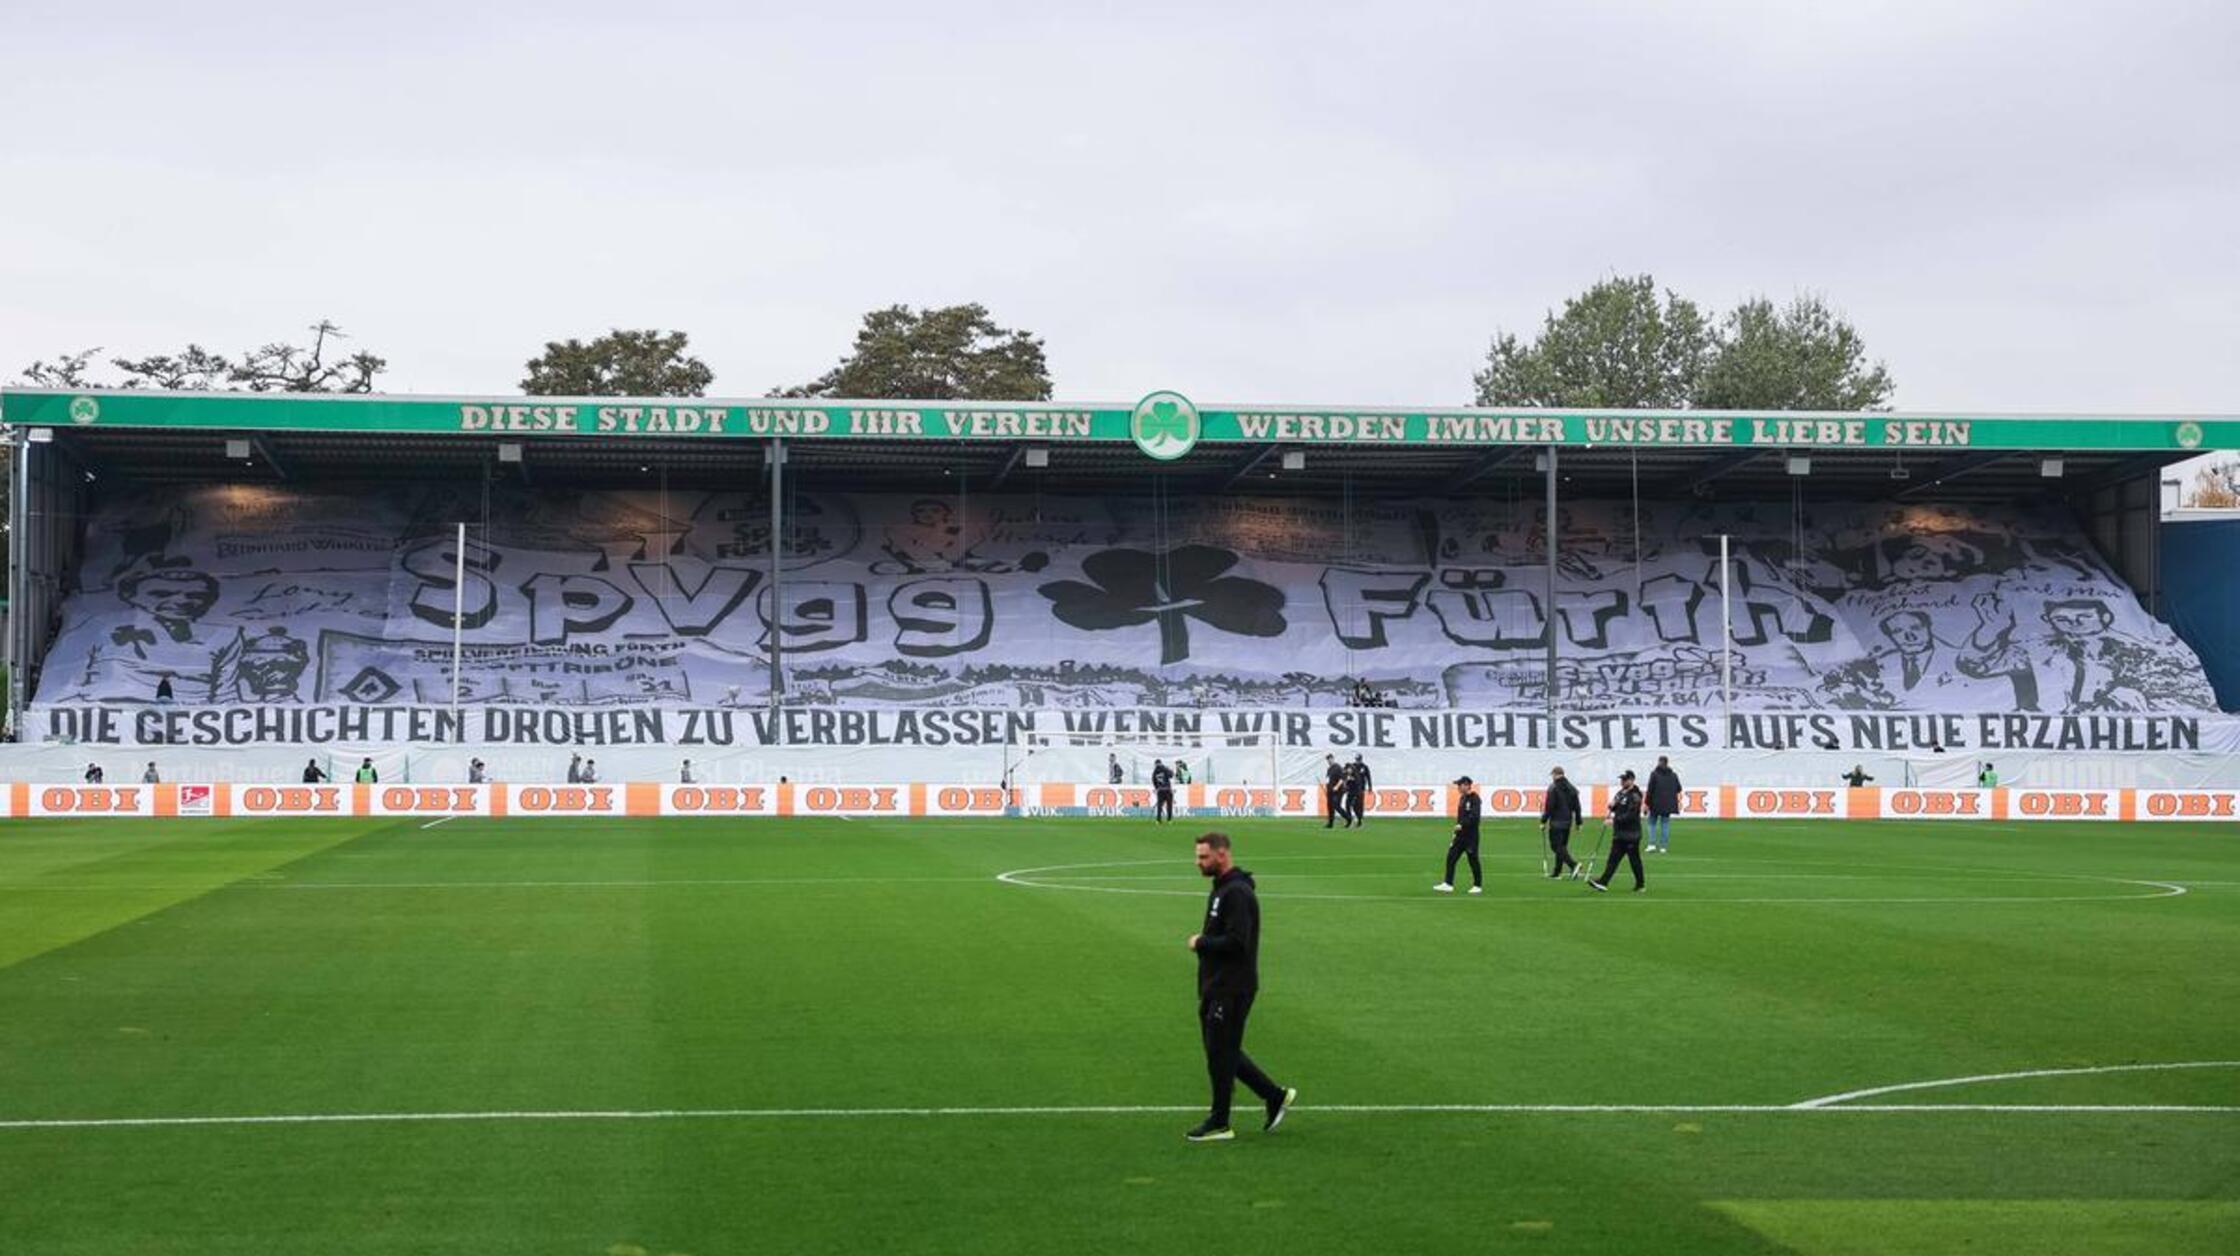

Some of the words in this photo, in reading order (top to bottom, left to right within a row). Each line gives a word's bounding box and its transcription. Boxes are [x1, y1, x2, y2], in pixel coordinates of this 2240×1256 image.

[460, 406, 578, 431] DIESE
[597, 407, 728, 433] STADT
[748, 408, 830, 434] UND
[850, 409, 924, 435] IHR
[943, 410, 1092, 437] VEREIN
[1238, 414, 1407, 440] WERDEN
[1425, 416, 1566, 442] IMMER
[1585, 417, 1732, 445] UNSERE
[1752, 419, 1866, 446] LIEBE
[1883, 420, 1972, 447] SEIN
[49, 706, 122, 743] DIE
[134, 705, 466, 746] GESCHICHTEN
[484, 707, 664, 745] DROHEN
[678, 709, 733, 745] ZU
[1063, 710, 1203, 748] WENN
[1219, 710, 1313, 748] WIR
[1327, 712, 1396, 748] SIE
[1410, 712, 1548, 749] NICHT
[1563, 713, 1709, 749] STETS
[1729, 714, 1840, 750] AUFS
[1850, 714, 1967, 750] NEUE
[41, 787, 139, 811] OBI
[242, 787, 337, 811] OBI
[382, 787, 475, 811] OBI
[519, 787, 611, 811] OBI
[671, 787, 763, 811] OBI
[806, 787, 896, 811] OBI
[1747, 790, 1833, 814] OBI
[1891, 791, 1979, 815] OBI
[2019, 792, 2107, 816] OBI
[2147, 792, 2235, 816] OBI
